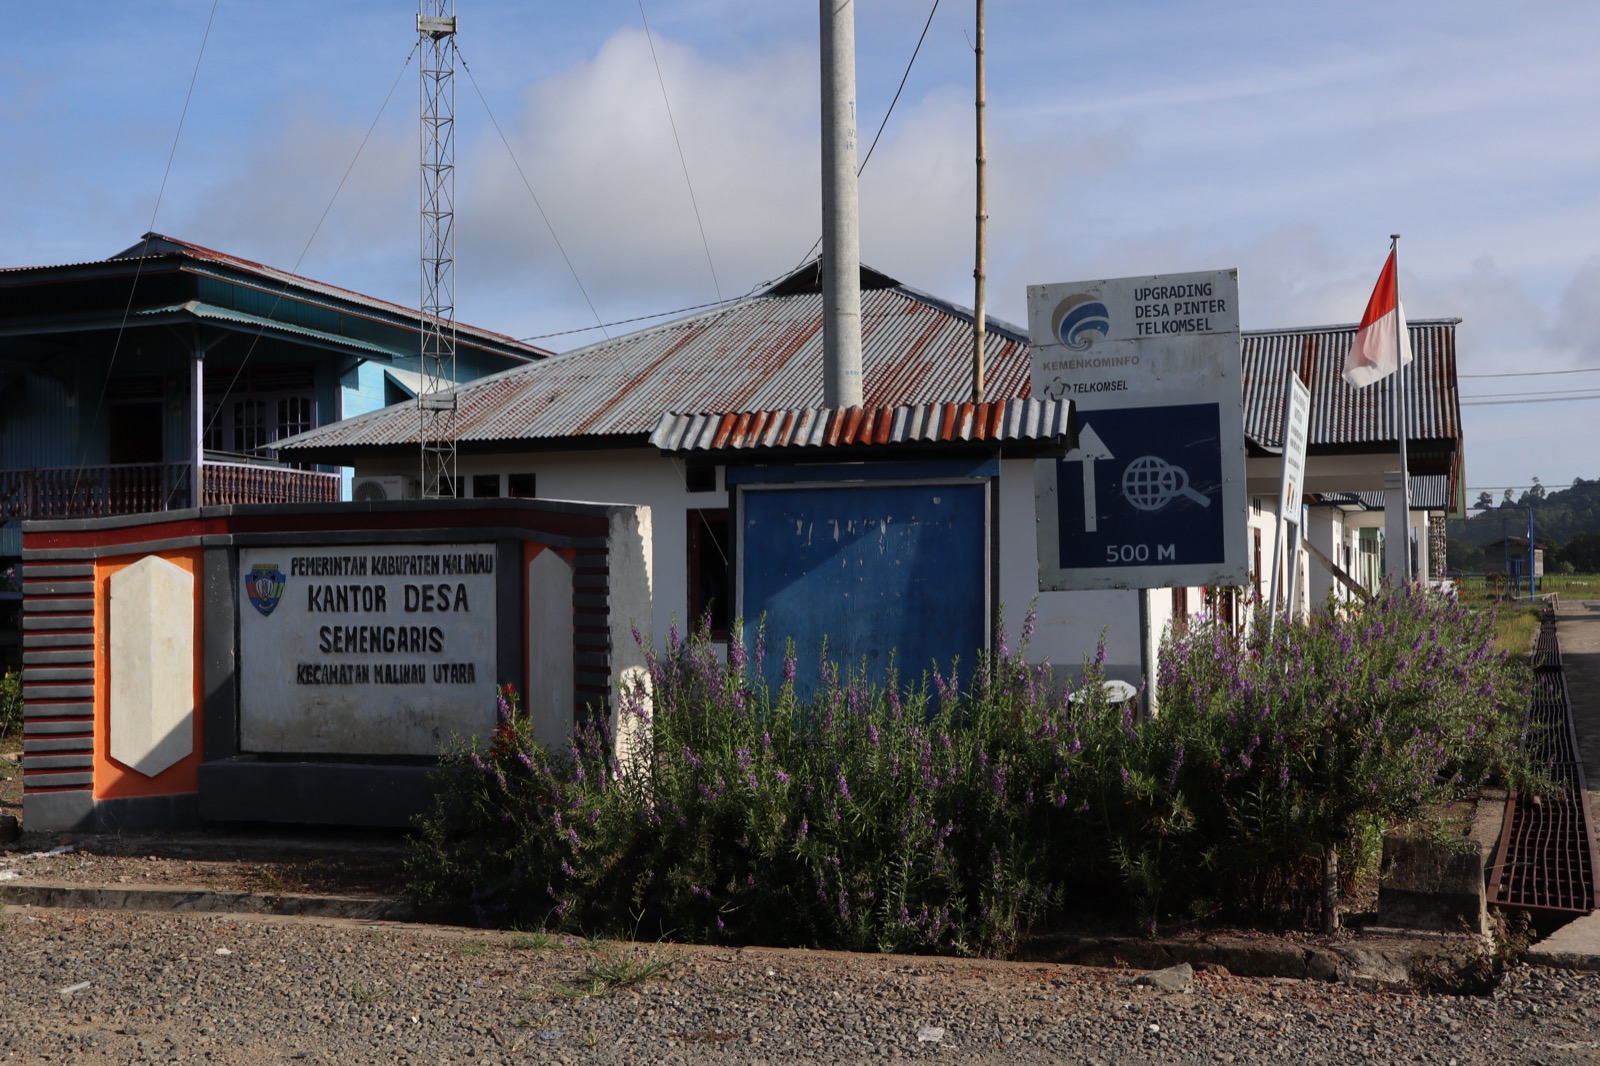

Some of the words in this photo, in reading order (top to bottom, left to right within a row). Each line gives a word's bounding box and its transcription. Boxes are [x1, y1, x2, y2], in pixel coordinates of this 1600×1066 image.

[1134, 283, 1212, 301] UPGRADING
[1135, 303, 1170, 319] DESA
[1174, 299, 1226, 316] PINTER
[1136, 318, 1213, 335] TELKOMSEL
[1042, 356, 1140, 371] KEMENKOMINFO
[1073, 380, 1128, 394] TELKOMSEL
[1106, 544, 1150, 563] 500
[1157, 544, 1176, 561] M
[291, 556, 367, 577] PEMERINTAH
[371, 555, 440, 576] KABUPATEN
[442, 554, 493, 575] MALINAU
[307, 584, 387, 613] KANTOR
[404, 583, 469, 613] DESA
[319, 626, 444, 653] SEMENGARIS
[297, 664, 370, 685] KECAMATAN
[374, 664, 426, 684] MALINAU
[433, 663, 475, 683] UTARA
